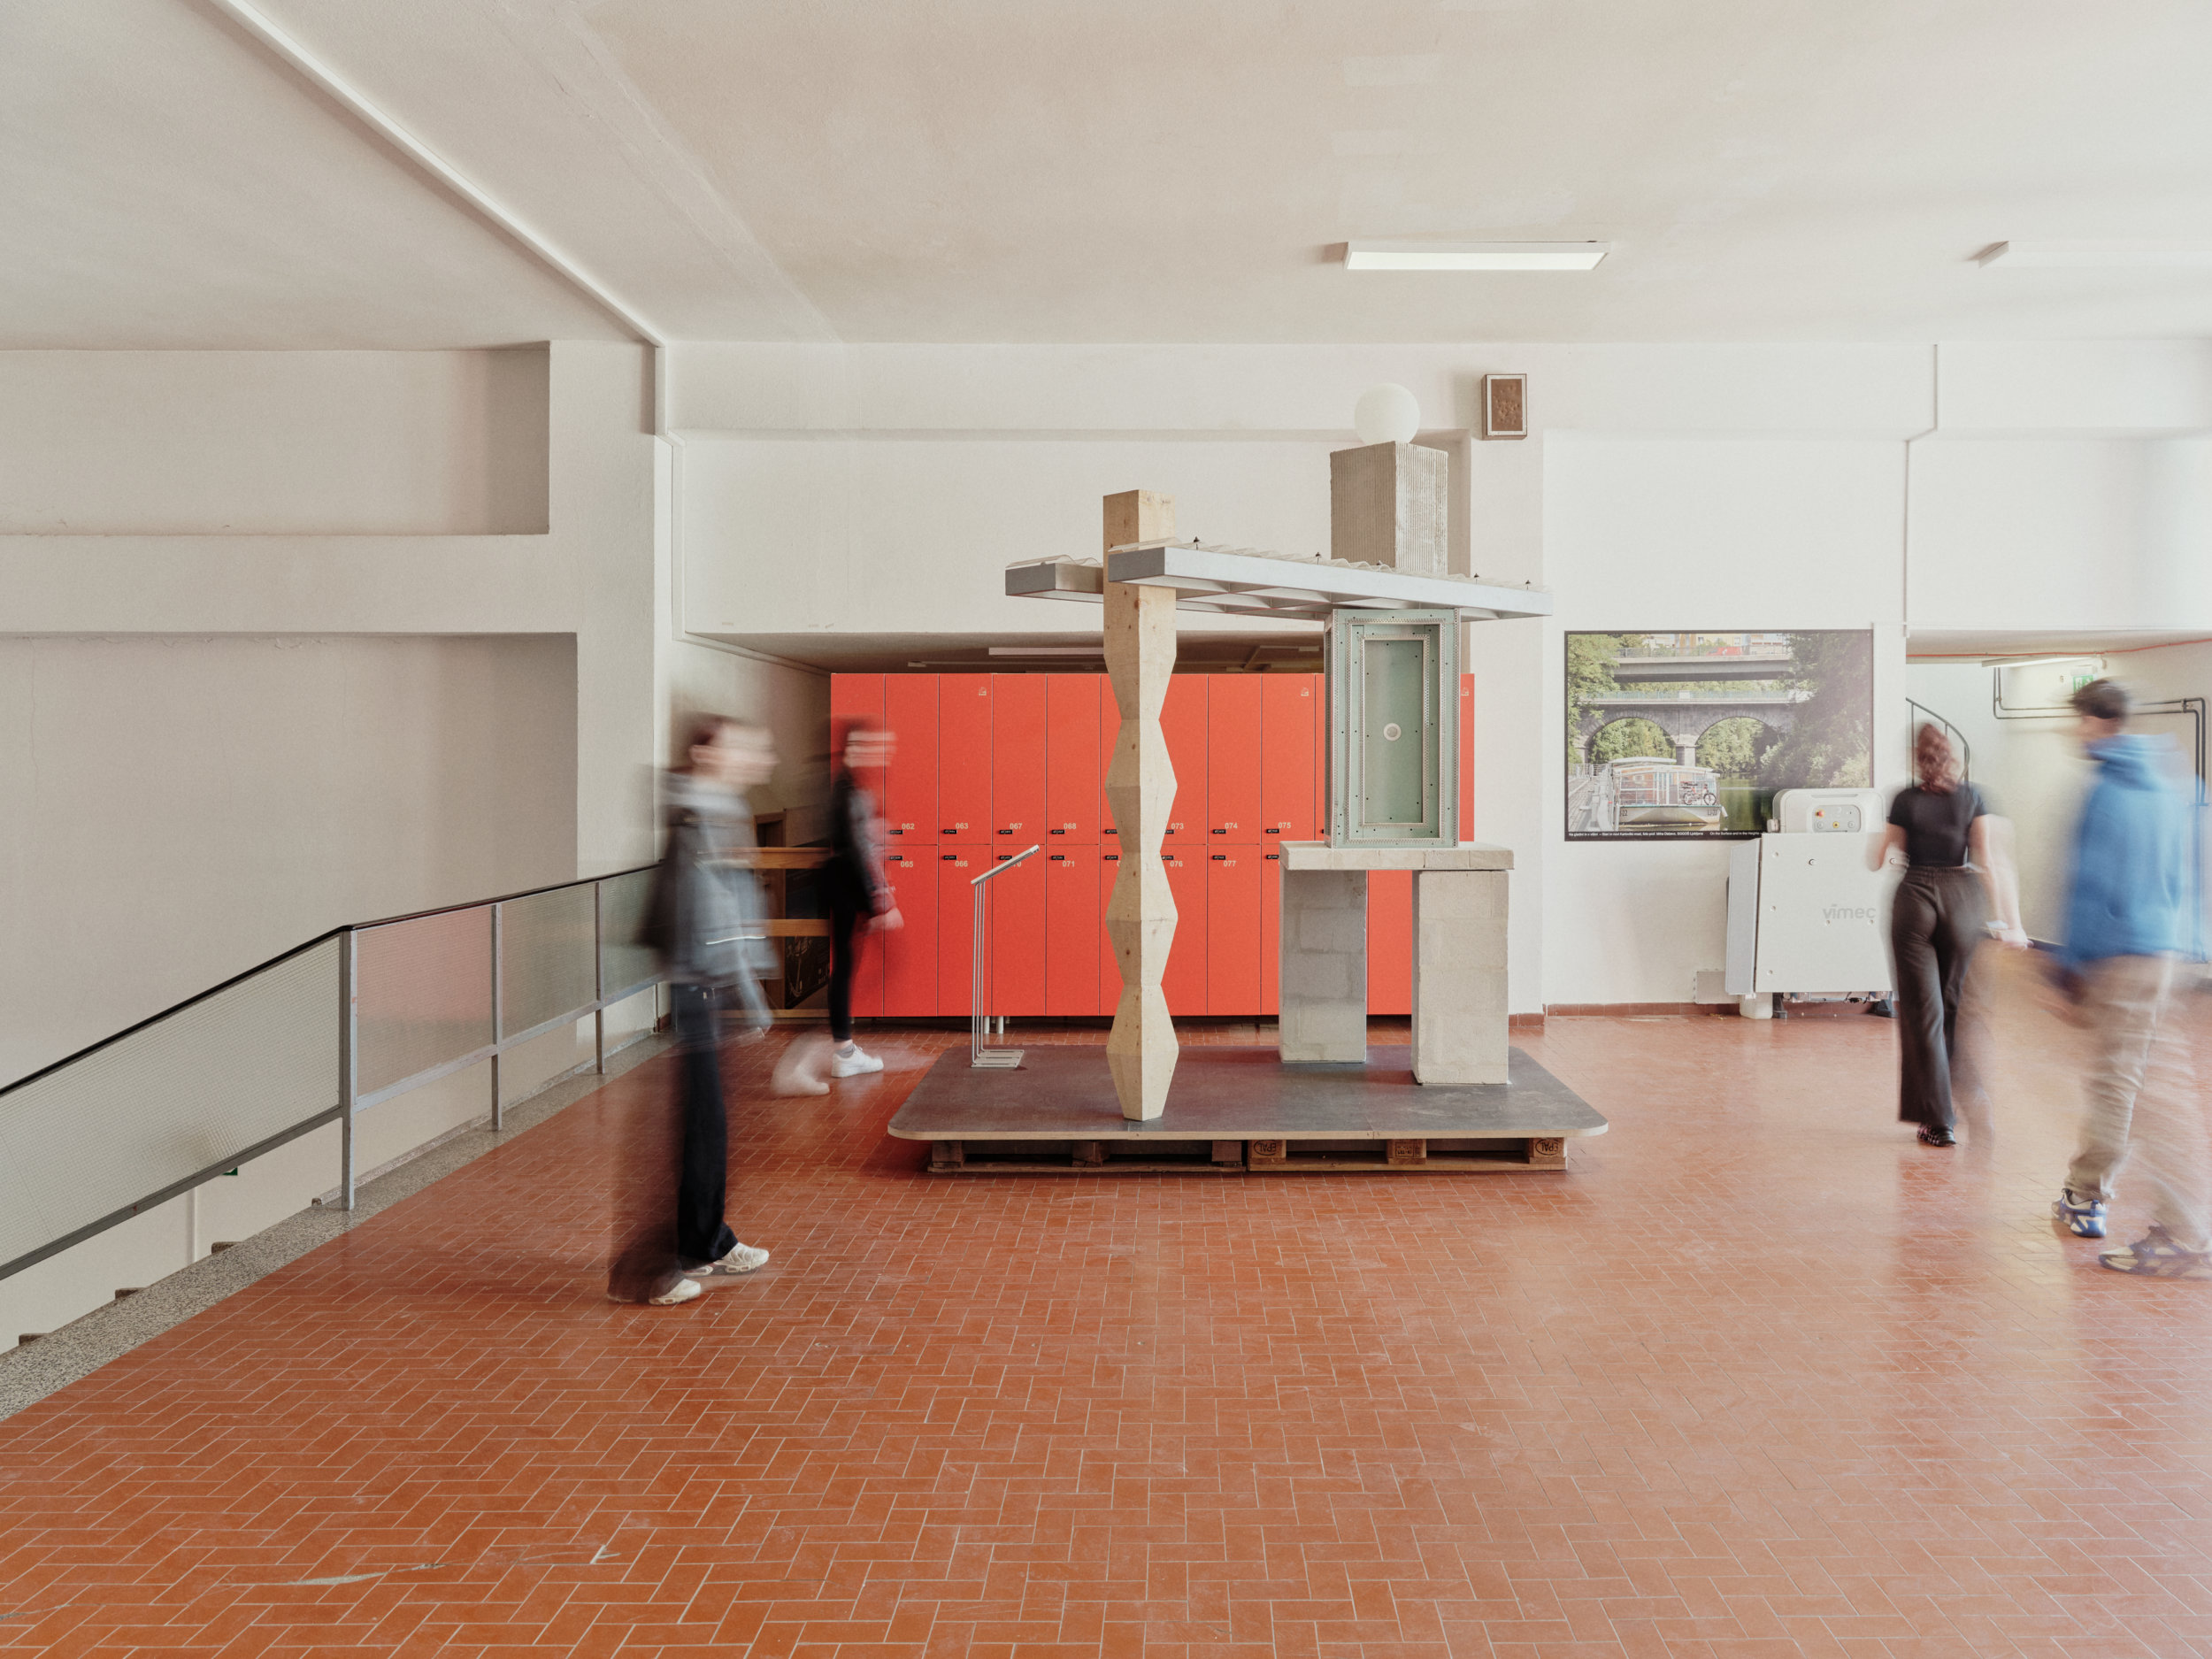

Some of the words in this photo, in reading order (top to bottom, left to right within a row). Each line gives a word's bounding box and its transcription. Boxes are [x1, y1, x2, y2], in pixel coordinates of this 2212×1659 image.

[1823, 903, 1876, 919] vimec
[1257, 1141, 1277, 1152] EPAL
[1540, 1141, 1558, 1152] EPAL
